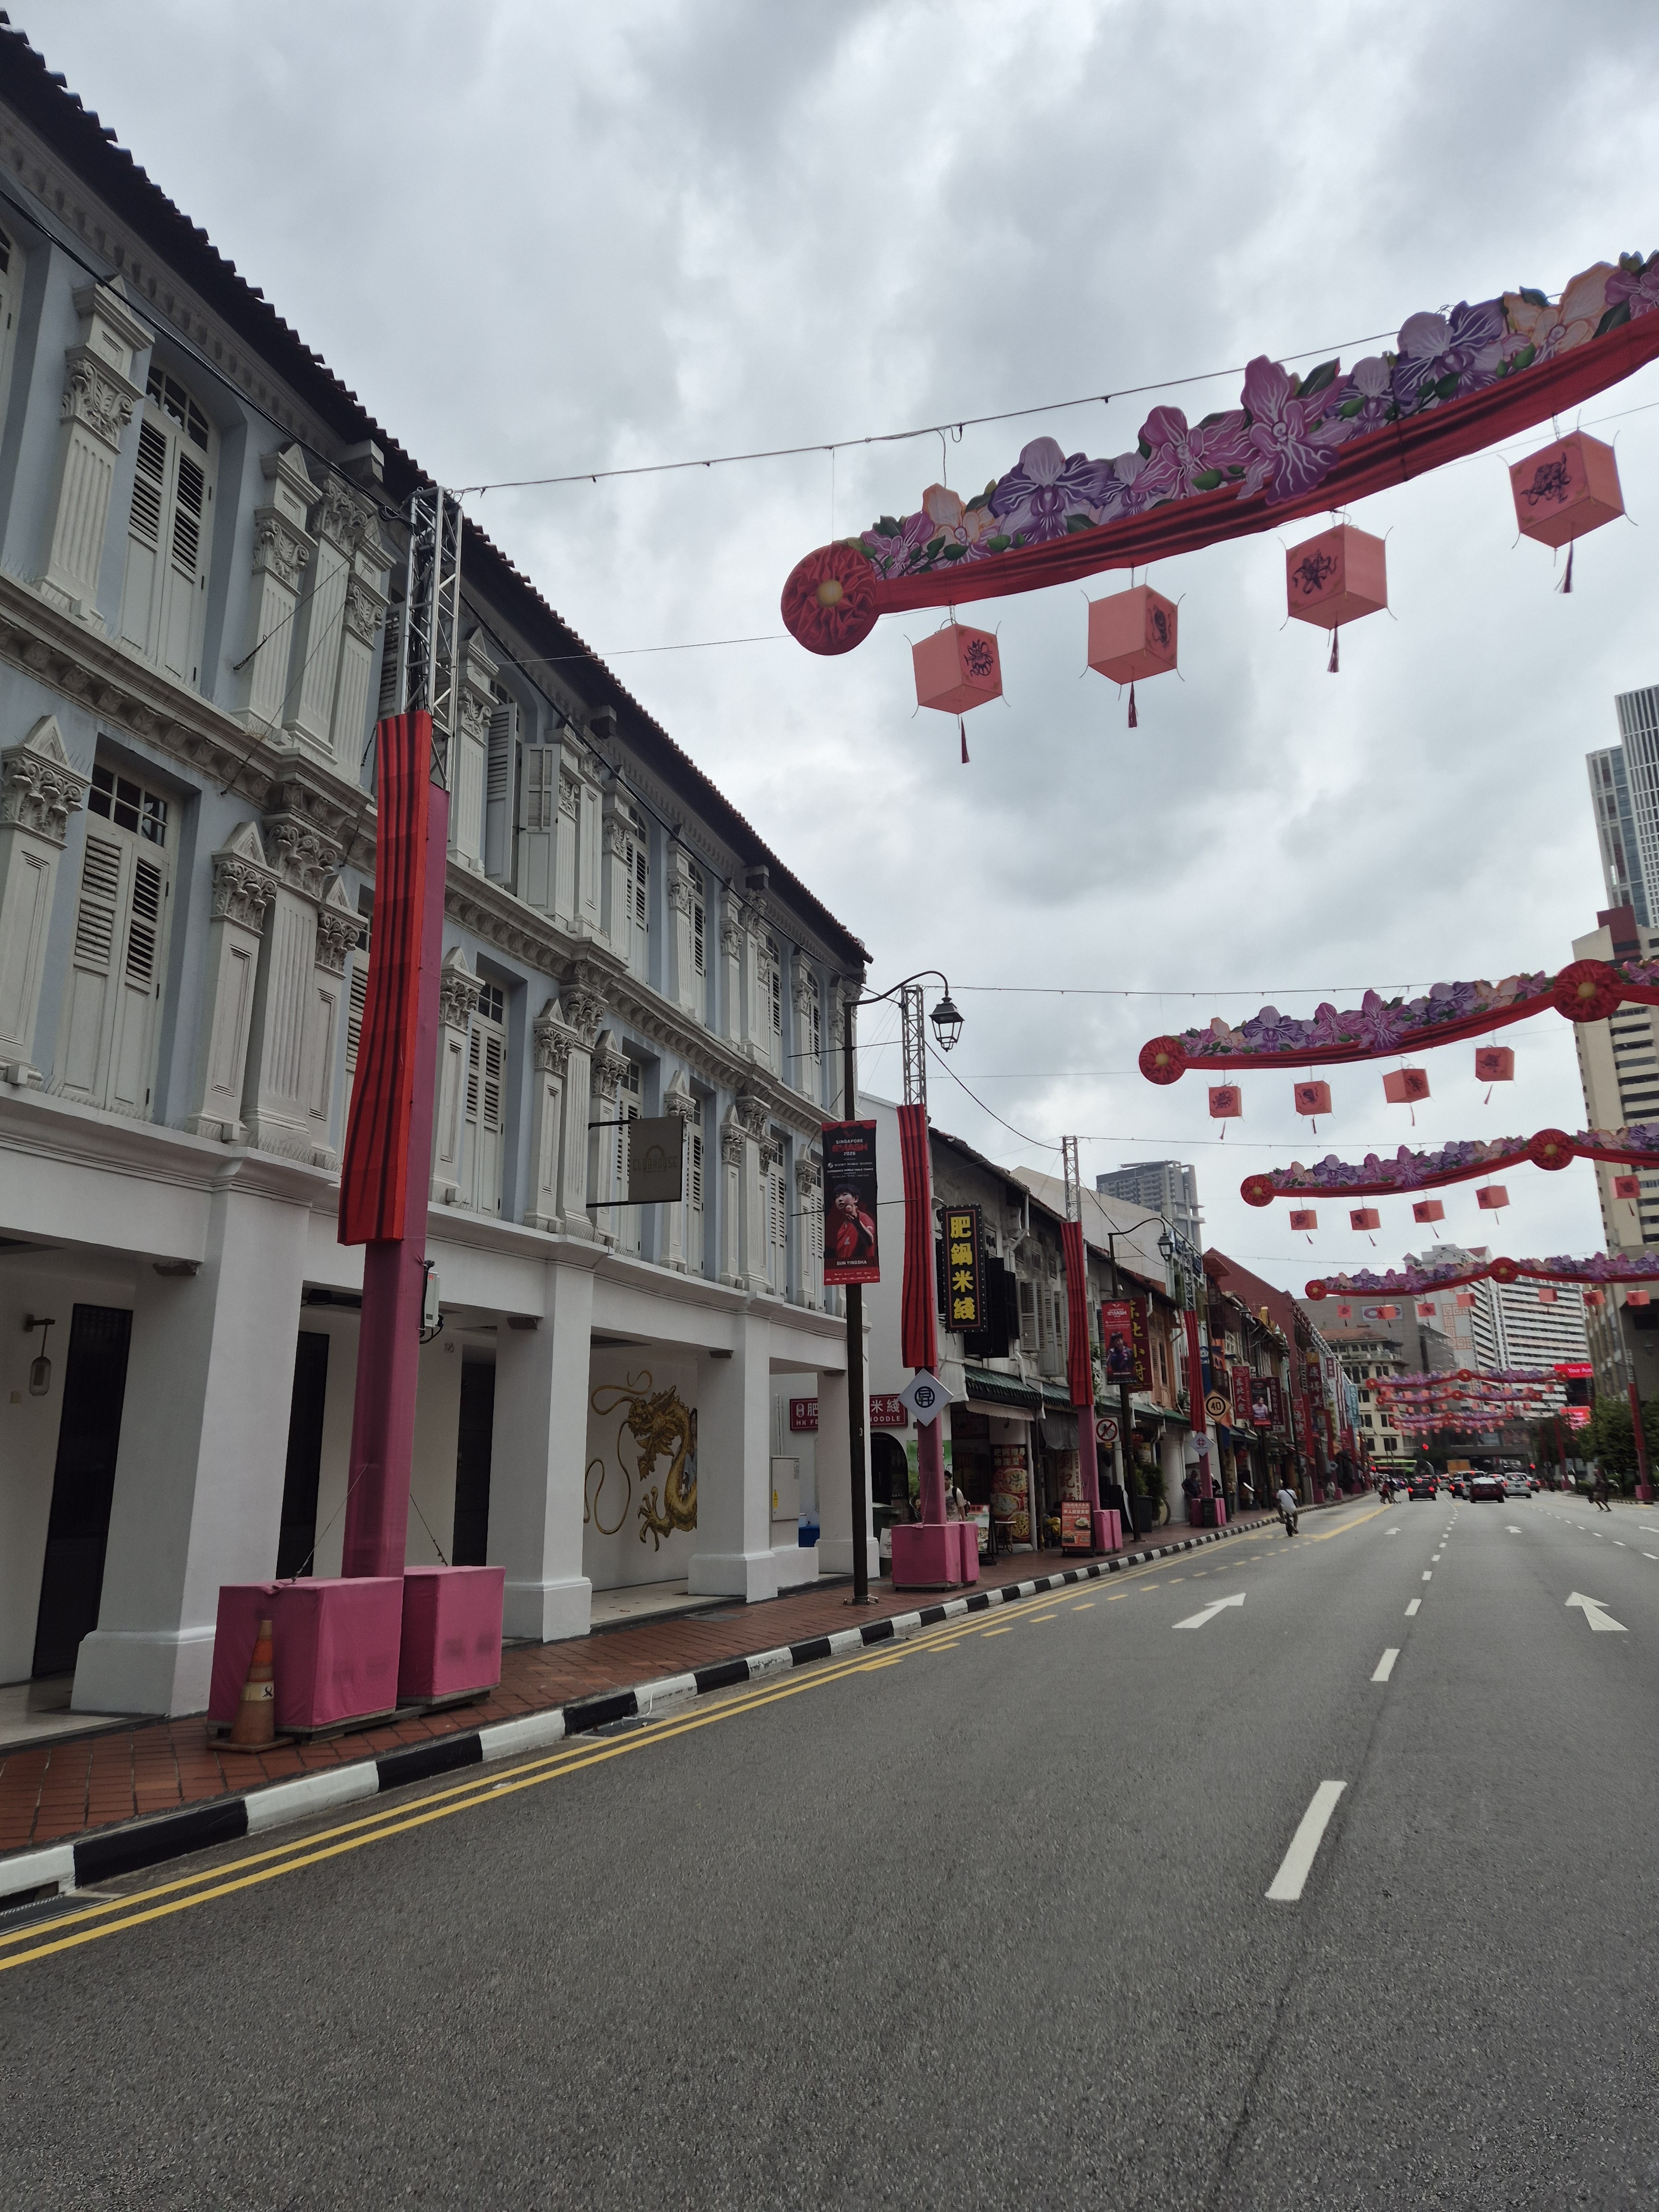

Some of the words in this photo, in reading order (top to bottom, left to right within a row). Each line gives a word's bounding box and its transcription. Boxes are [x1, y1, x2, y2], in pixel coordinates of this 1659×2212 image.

[633, 1156, 677, 1171] CLUBHOUSE
[1211, 1402, 1221, 1410] 40
[859, 1428, 863, 1436] 3
